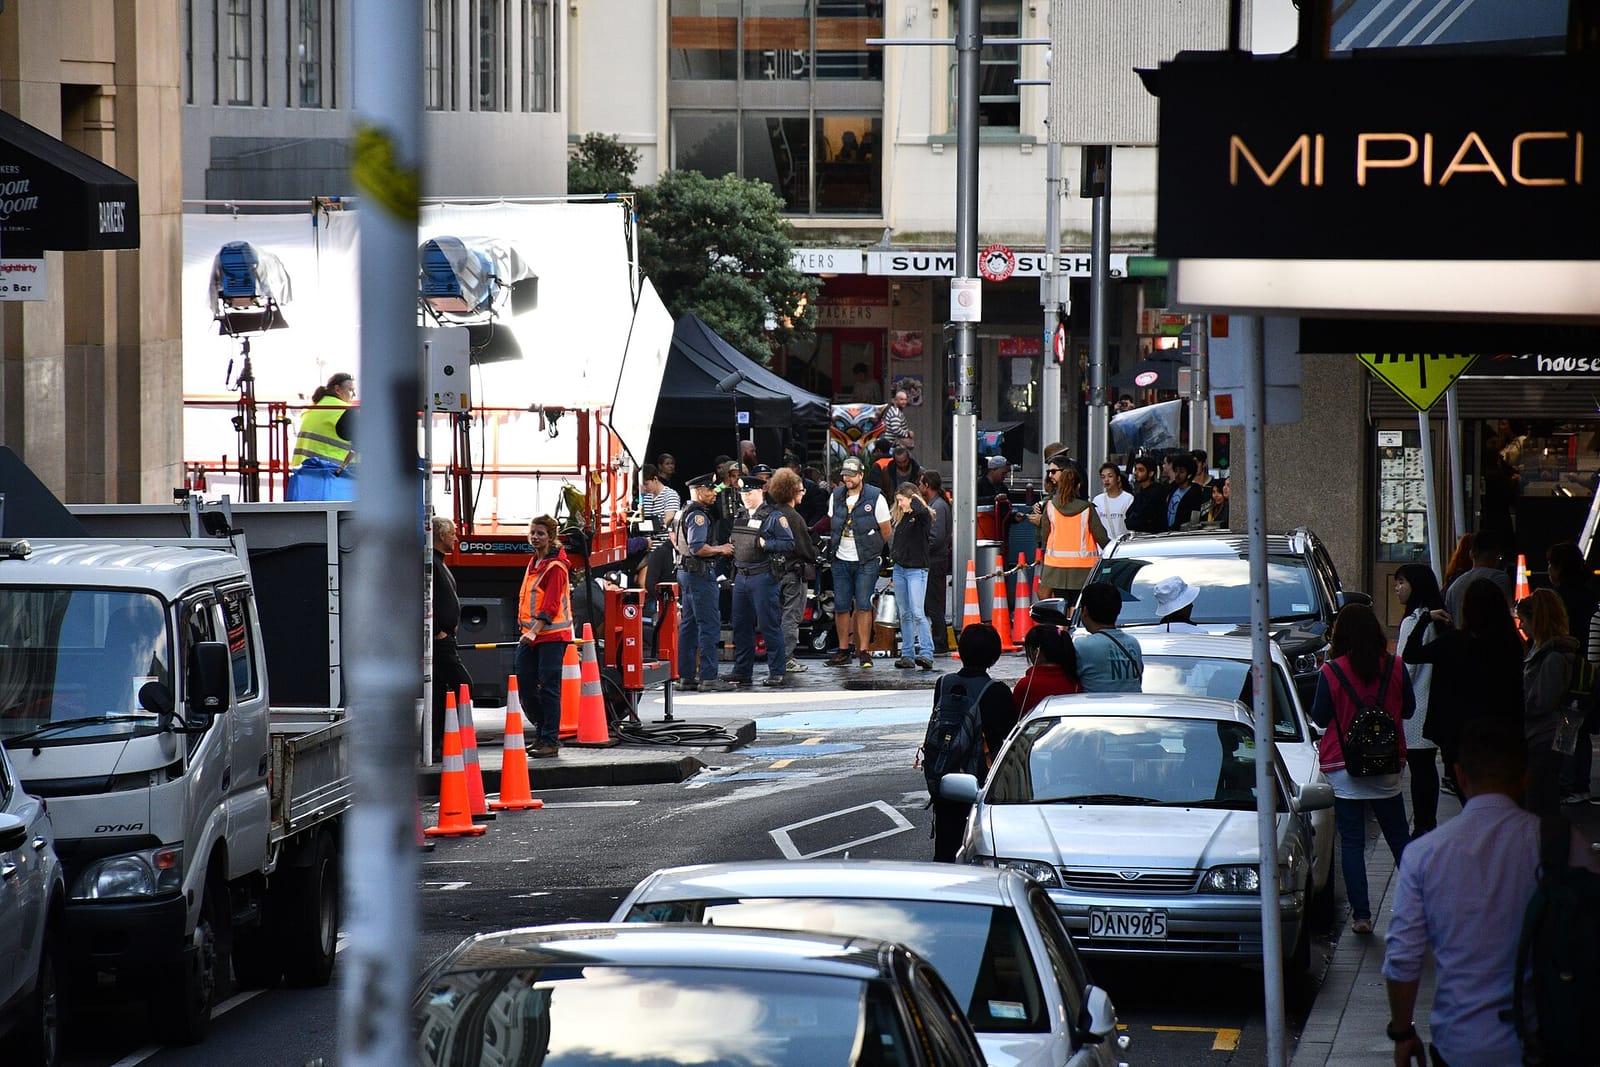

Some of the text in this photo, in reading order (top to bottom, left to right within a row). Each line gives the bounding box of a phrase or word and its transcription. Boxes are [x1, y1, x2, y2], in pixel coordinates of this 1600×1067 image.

[1230, 131, 1584, 187] MI PIACI
[892, 256, 1091, 273] SUM SUSH
[13, 284, 33, 292] Bar
[94, 822, 144, 833] DYNA
[1091, 913, 1165, 936] DAN905
